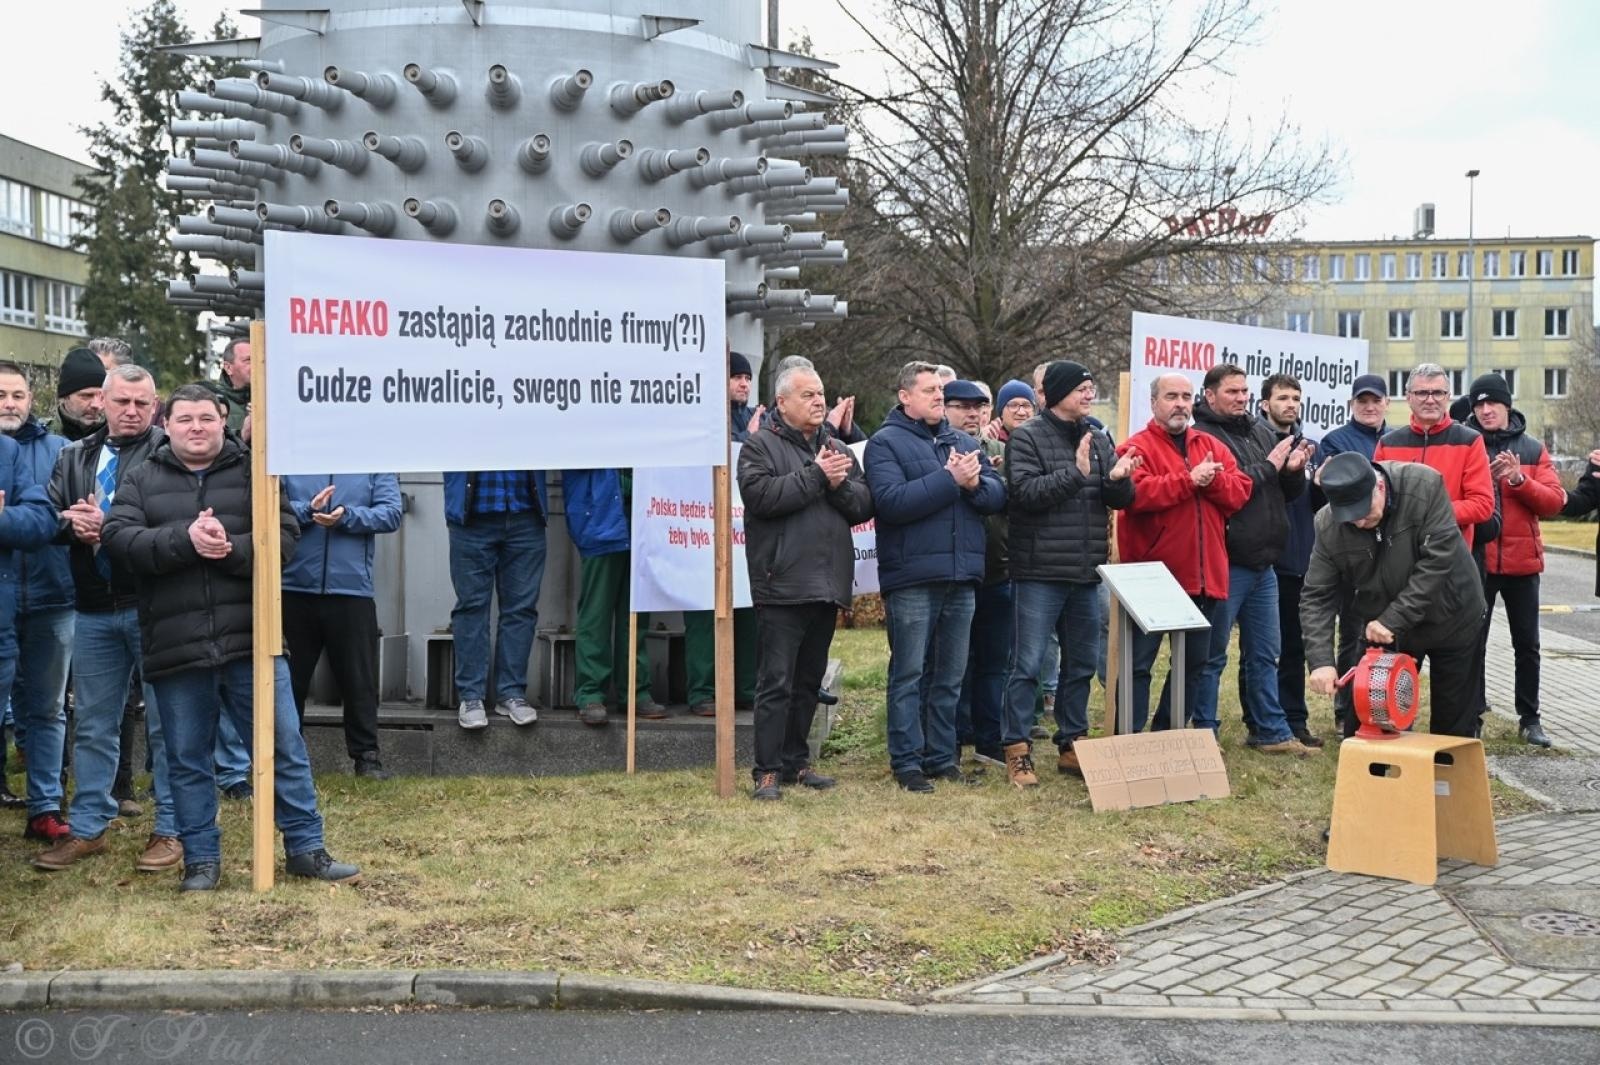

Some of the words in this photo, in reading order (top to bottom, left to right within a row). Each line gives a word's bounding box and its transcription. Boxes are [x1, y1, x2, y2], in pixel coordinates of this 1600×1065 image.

[290, 297, 388, 337] RAFAKO
[398, 304, 496, 348] zastąpią
[504, 308, 612, 343] zachodnie
[620, 311, 705, 352] firmy(?!)
[1144, 336, 1215, 371] RAFAKO
[1222, 346, 1239, 365] to
[1246, 350, 1271, 377] nie
[1279, 351, 1359, 389] ideologia!
[298, 365, 371, 403] Cudze
[383, 368, 503, 409] chwalicie,
[513, 377, 581, 411] swego
[590, 371, 622, 404] nie
[629, 373, 701, 404] znacie!
[680, 499, 706, 521] będzie
[668, 525, 688, 548] żeby
[690, 526, 711, 549] była
